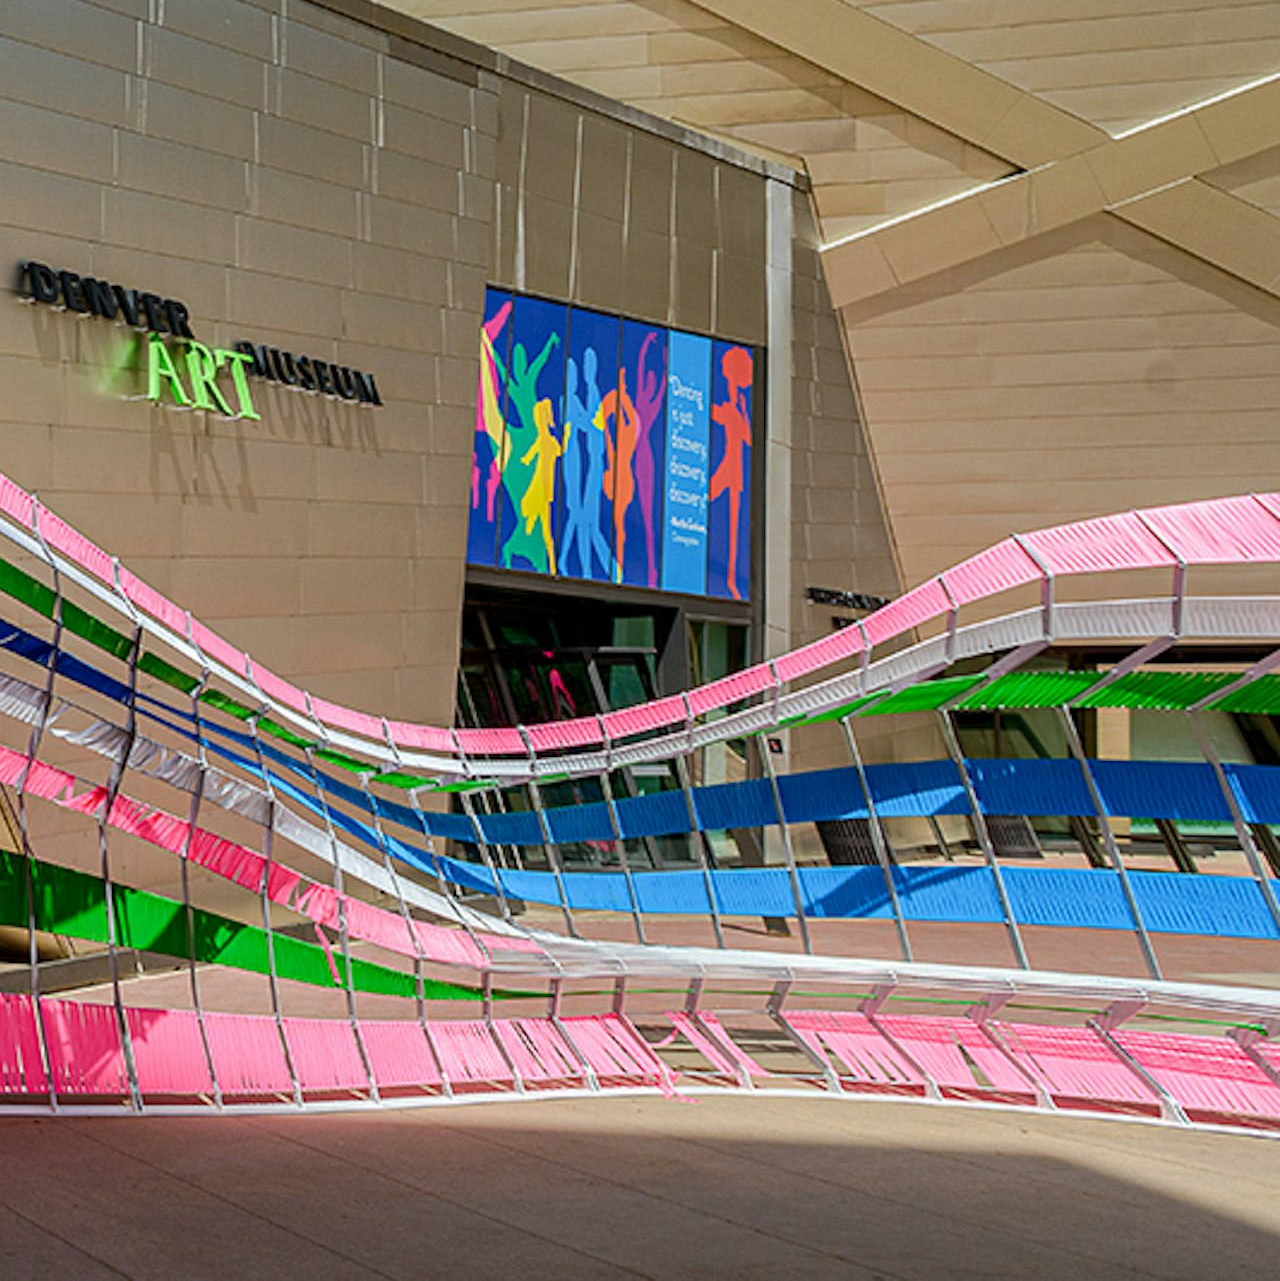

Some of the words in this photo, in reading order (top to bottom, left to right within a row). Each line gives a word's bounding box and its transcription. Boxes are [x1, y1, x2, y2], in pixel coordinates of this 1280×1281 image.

[15, 260, 195, 339] DENVER
[147, 331, 261, 420] ART
[236, 339, 383, 406] MUSEUM
